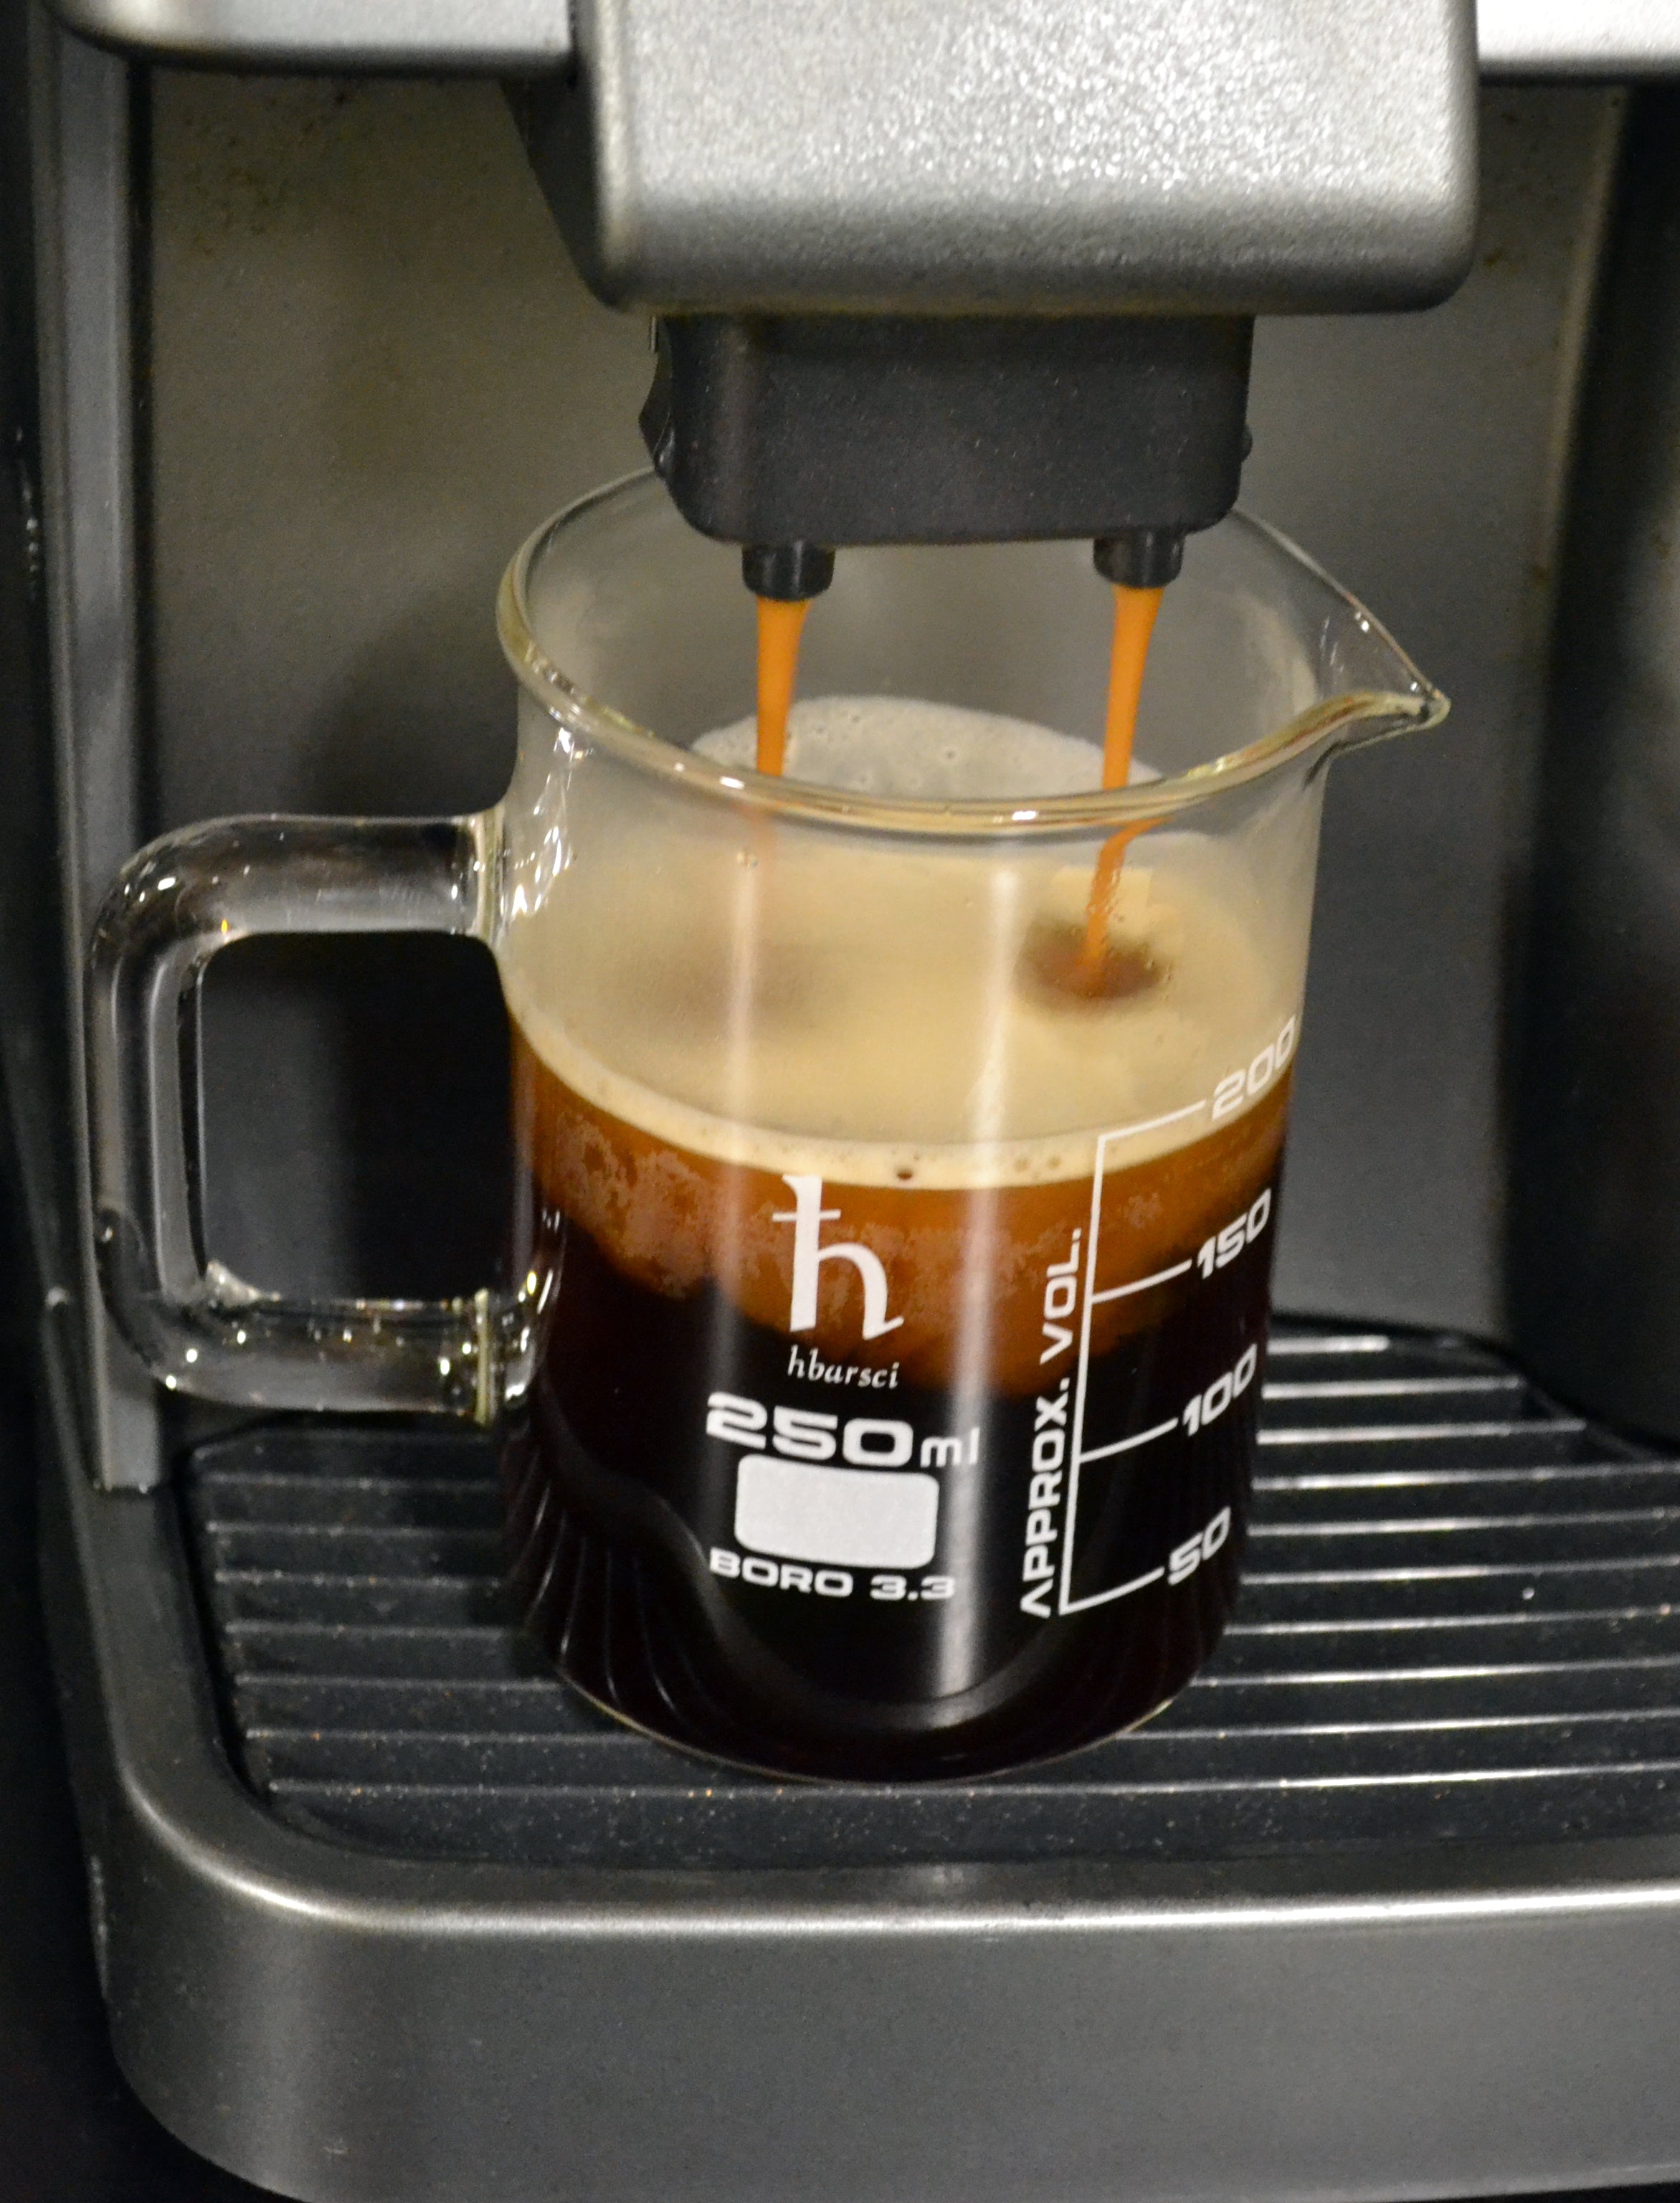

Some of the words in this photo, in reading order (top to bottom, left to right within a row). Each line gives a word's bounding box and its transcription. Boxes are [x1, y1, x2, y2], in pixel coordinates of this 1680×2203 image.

[1210, 1015, 1296, 1121] 200
[1195, 1188, 1272, 1279] 150
[1040, 1227, 1082, 1365] VOL.
[787, 1345, 900, 1389] hbarsci
[1182, 1343, 1258, 1436] 100
[1020, 1377, 1071, 1620] APPROX.
[708, 1546, 854, 1598] BORO
[870, 1575, 957, 1601] 3.3
[1167, 1506, 1233, 1587] 50
